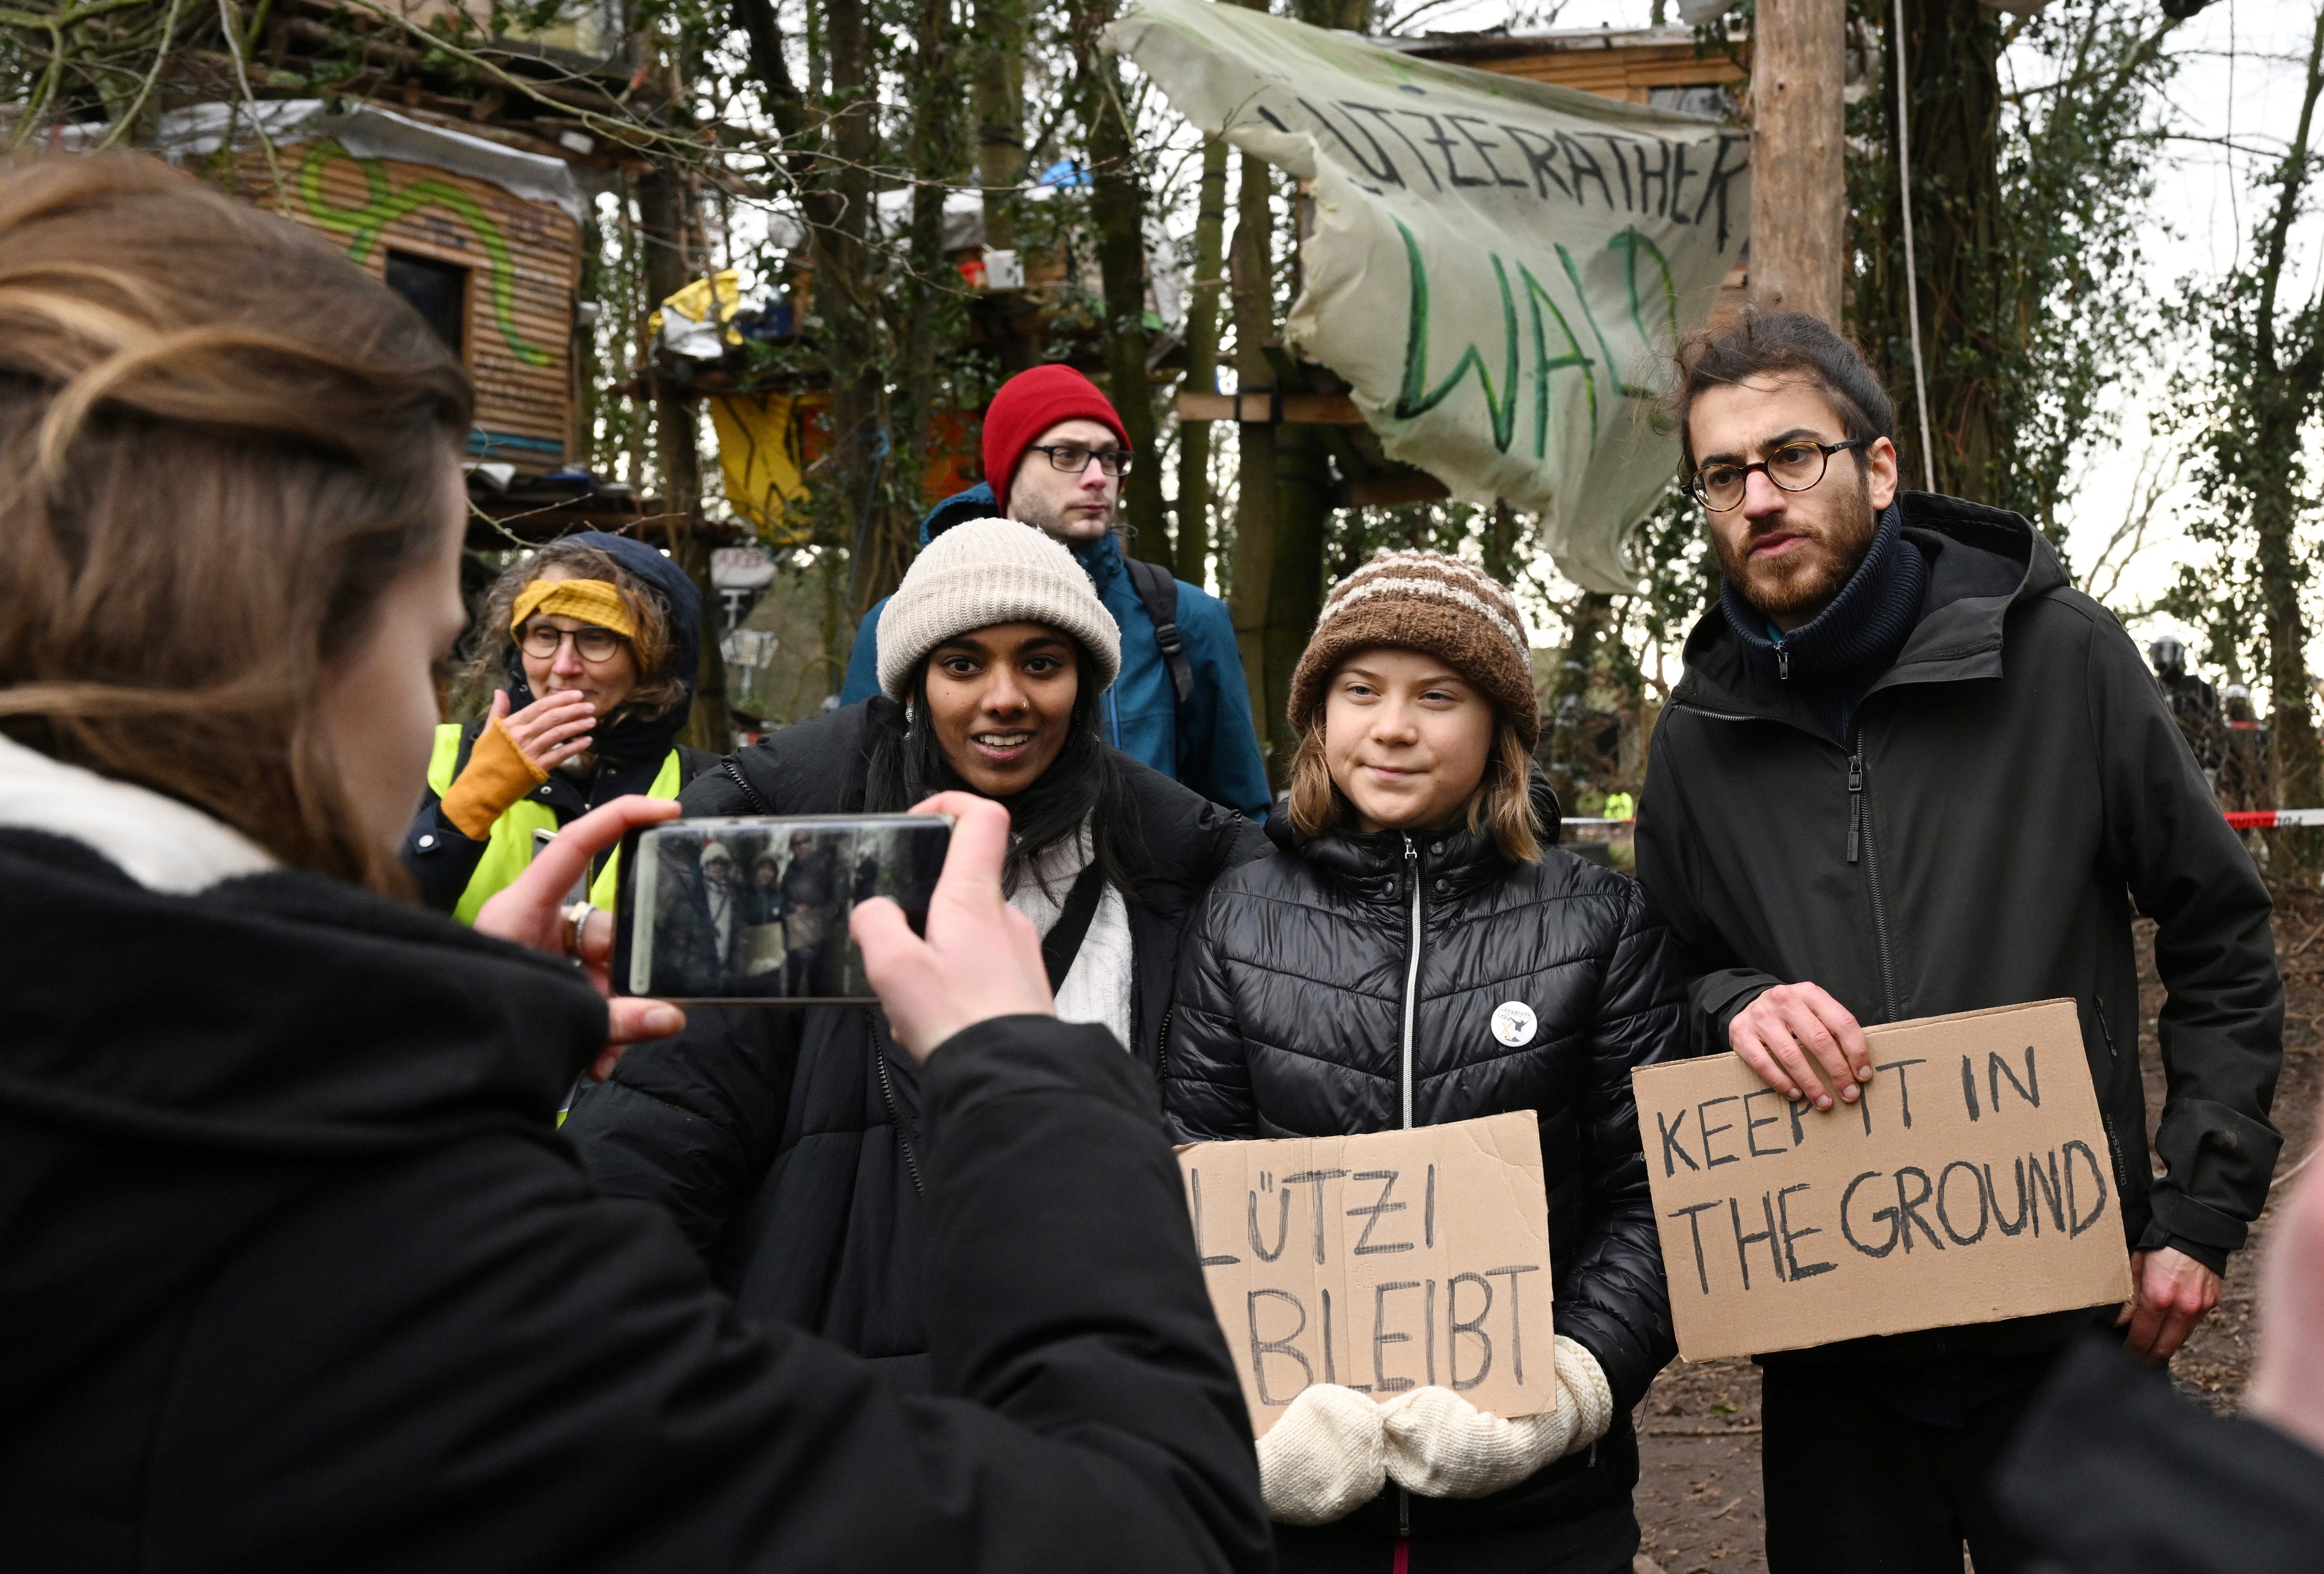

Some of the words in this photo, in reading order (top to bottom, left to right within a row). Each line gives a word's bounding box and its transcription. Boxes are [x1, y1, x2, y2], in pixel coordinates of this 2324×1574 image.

[1657, 1088, 1813, 1178] KEEP
[1859, 1058, 1927, 1137] IT
[1961, 1046, 2040, 1122] IN
[2106, 1113, 2127, 1186] DIDRIKSONS
[1191, 1164, 1435, 1266] LÜTZI
[1668, 1183, 1838, 1295] THE
[1840, 1139, 2107, 1258] GROUND
[1248, 1265, 1540, 1406] BLEIBT
